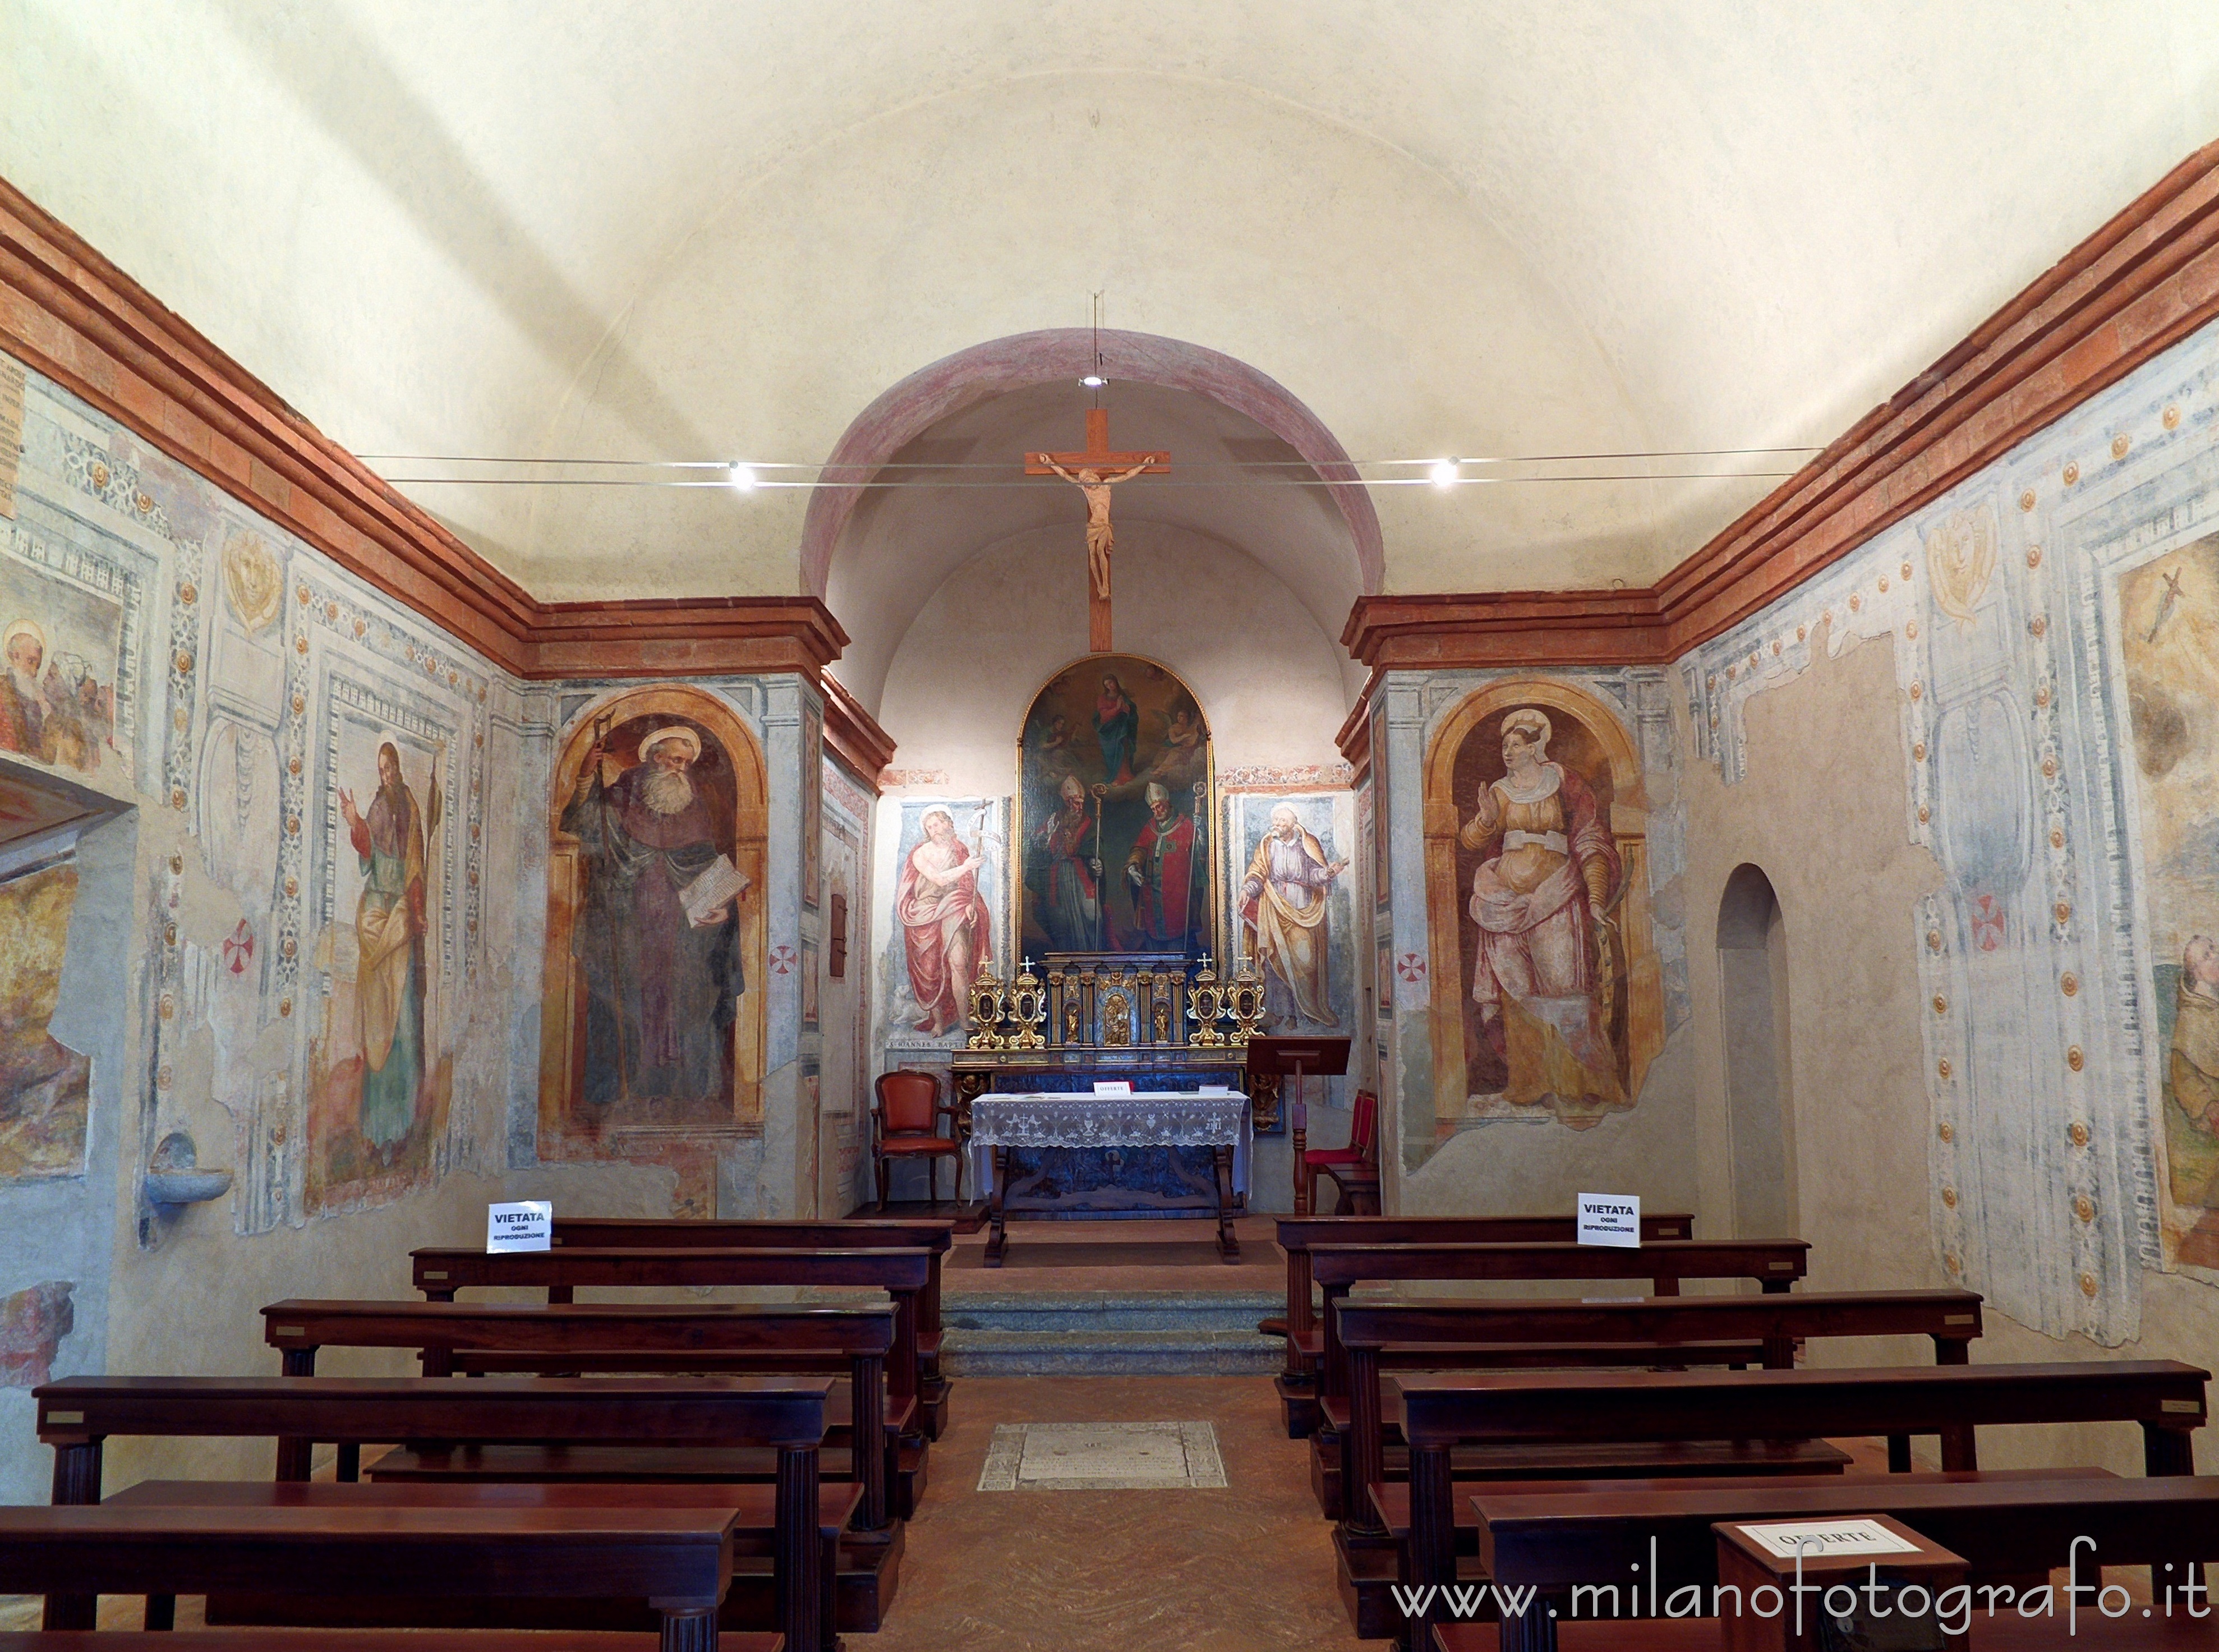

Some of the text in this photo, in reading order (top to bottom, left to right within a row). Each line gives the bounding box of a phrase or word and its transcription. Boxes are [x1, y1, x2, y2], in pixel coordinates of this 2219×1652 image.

[1584, 1204, 1634, 1215] VIETATA
[495, 1213, 544, 1223] VIETATA
[1779, 1532, 1876, 1545] OERTE
